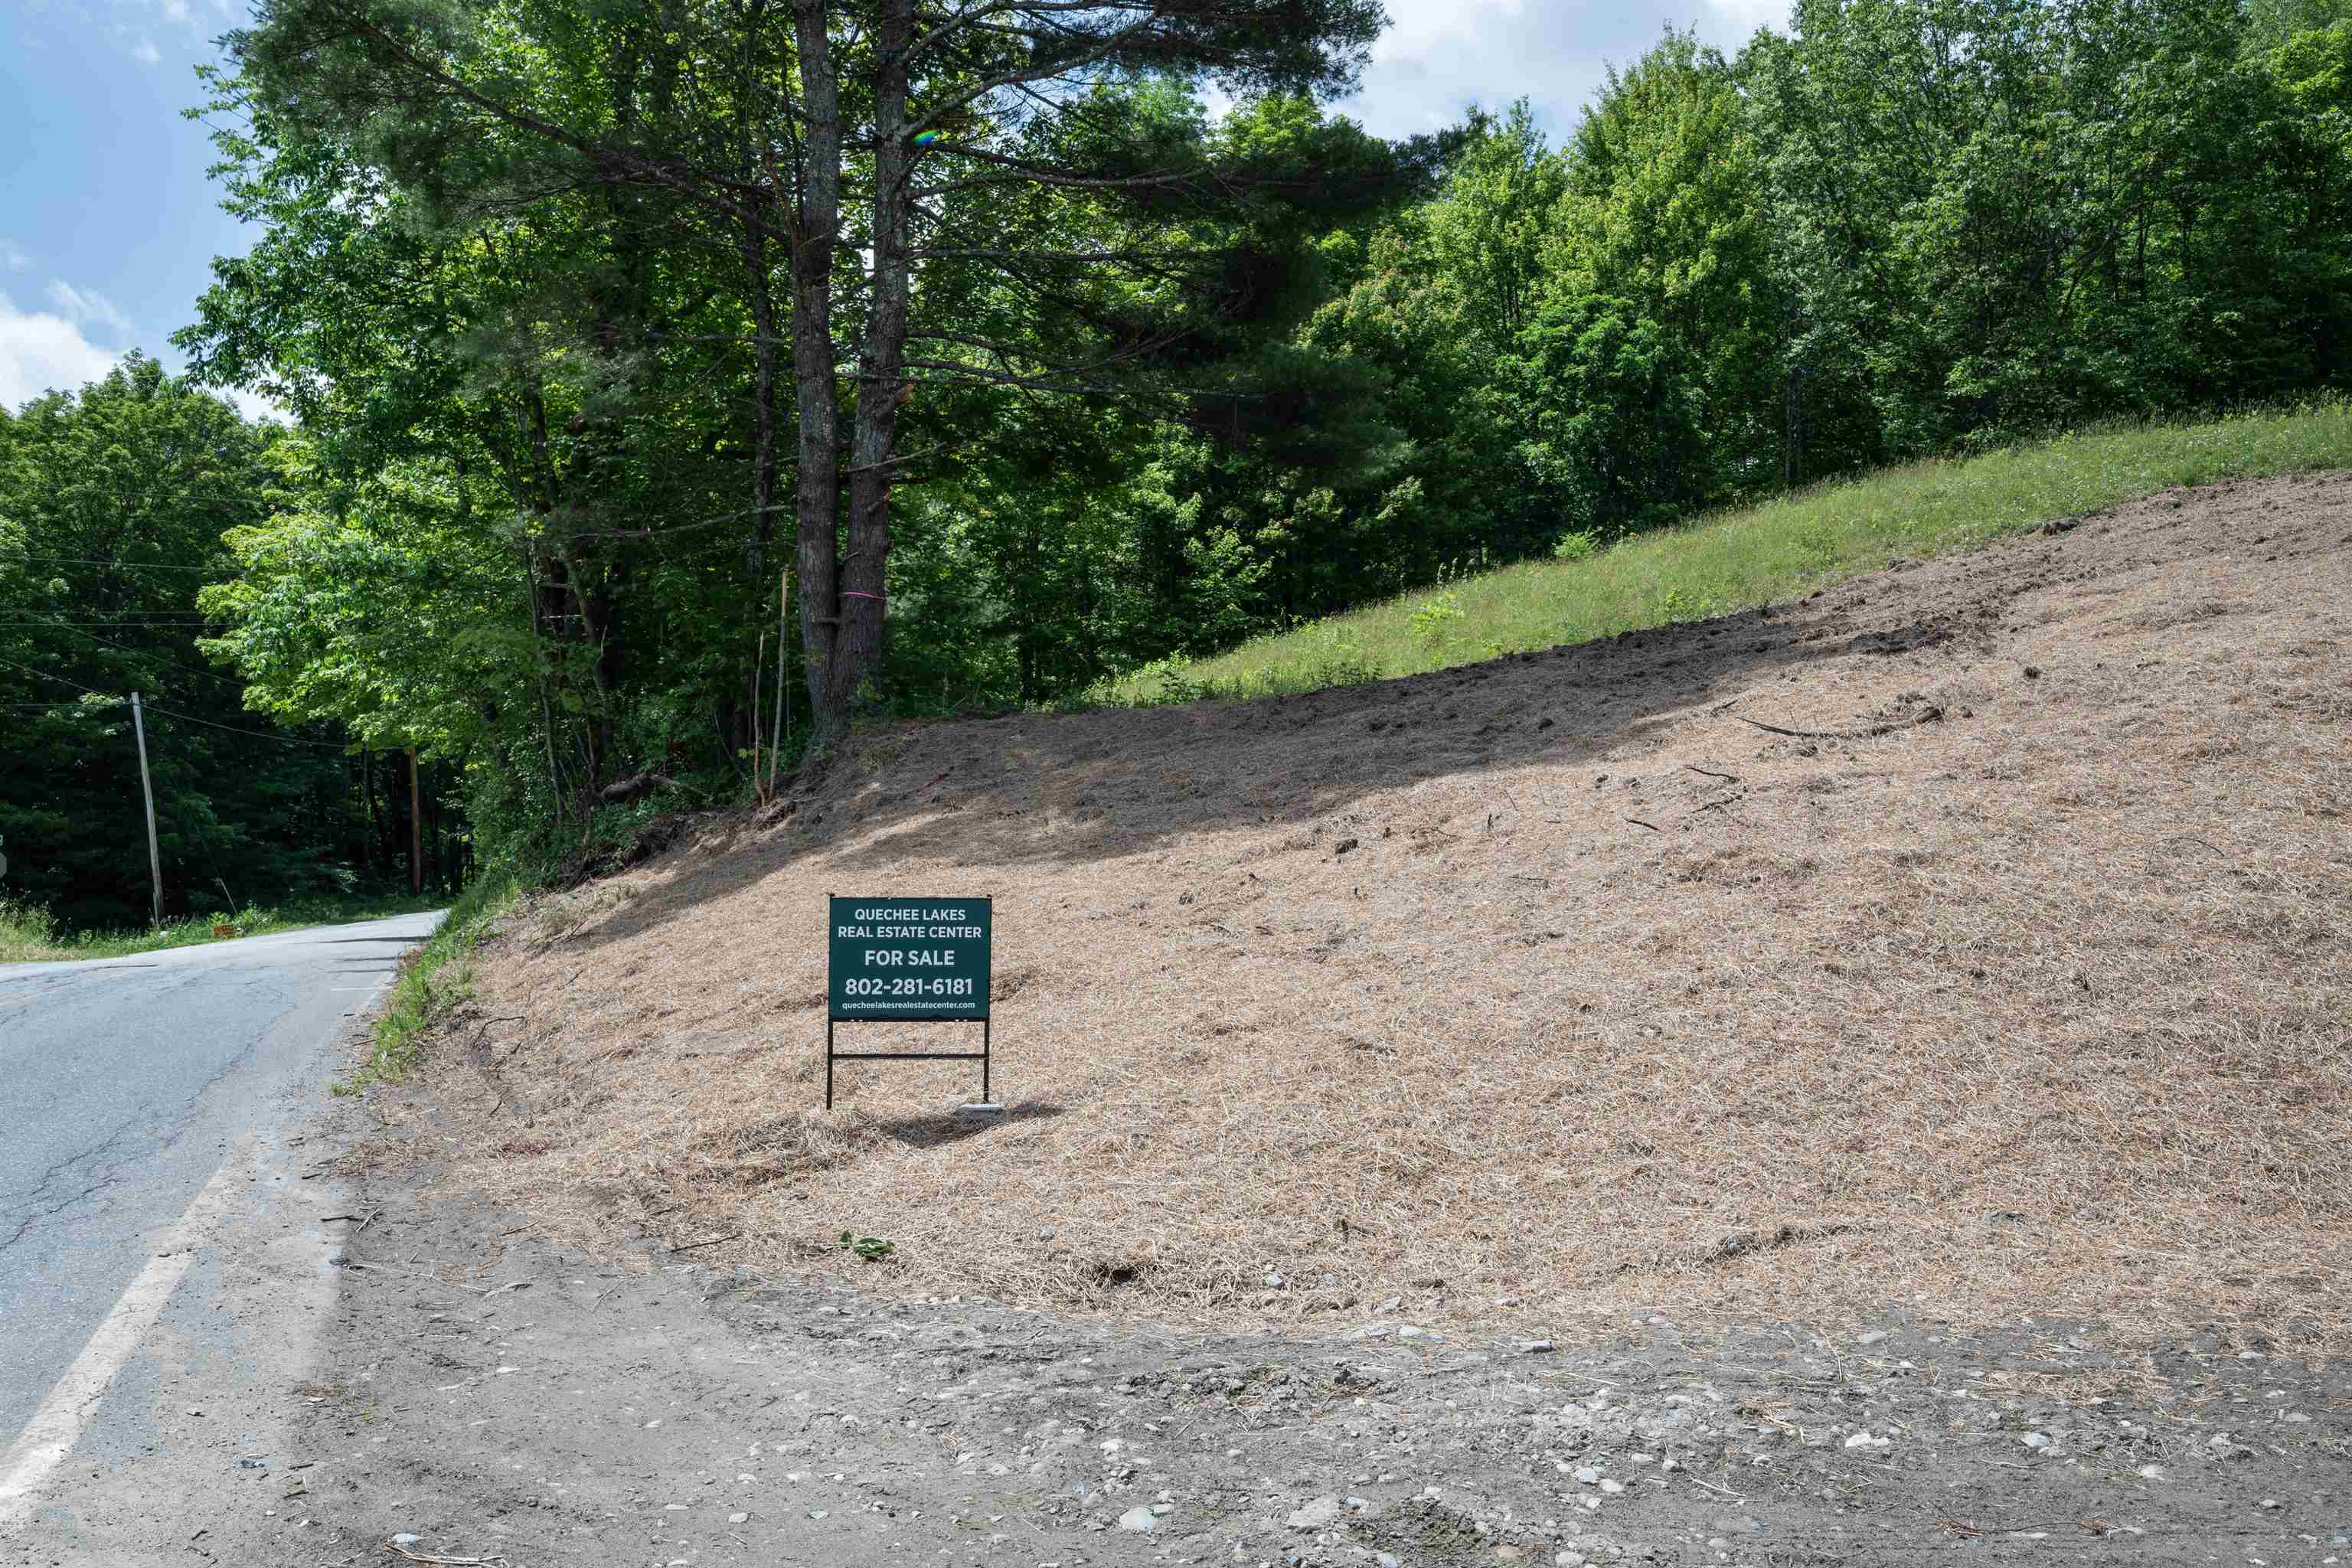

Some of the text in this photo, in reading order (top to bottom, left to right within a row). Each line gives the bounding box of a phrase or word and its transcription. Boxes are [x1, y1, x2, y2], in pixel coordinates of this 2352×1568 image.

[854, 909, 965, 921] QUECHEE LAKES
[838, 926, 982, 938] REAL ESTATE CENTER
[864, 949, 955, 965] FOR SALE
[844, 978, 972, 995] 802-281-6181
[841, 1001, 975, 1009] quecheelakesrealestatecenter.com
